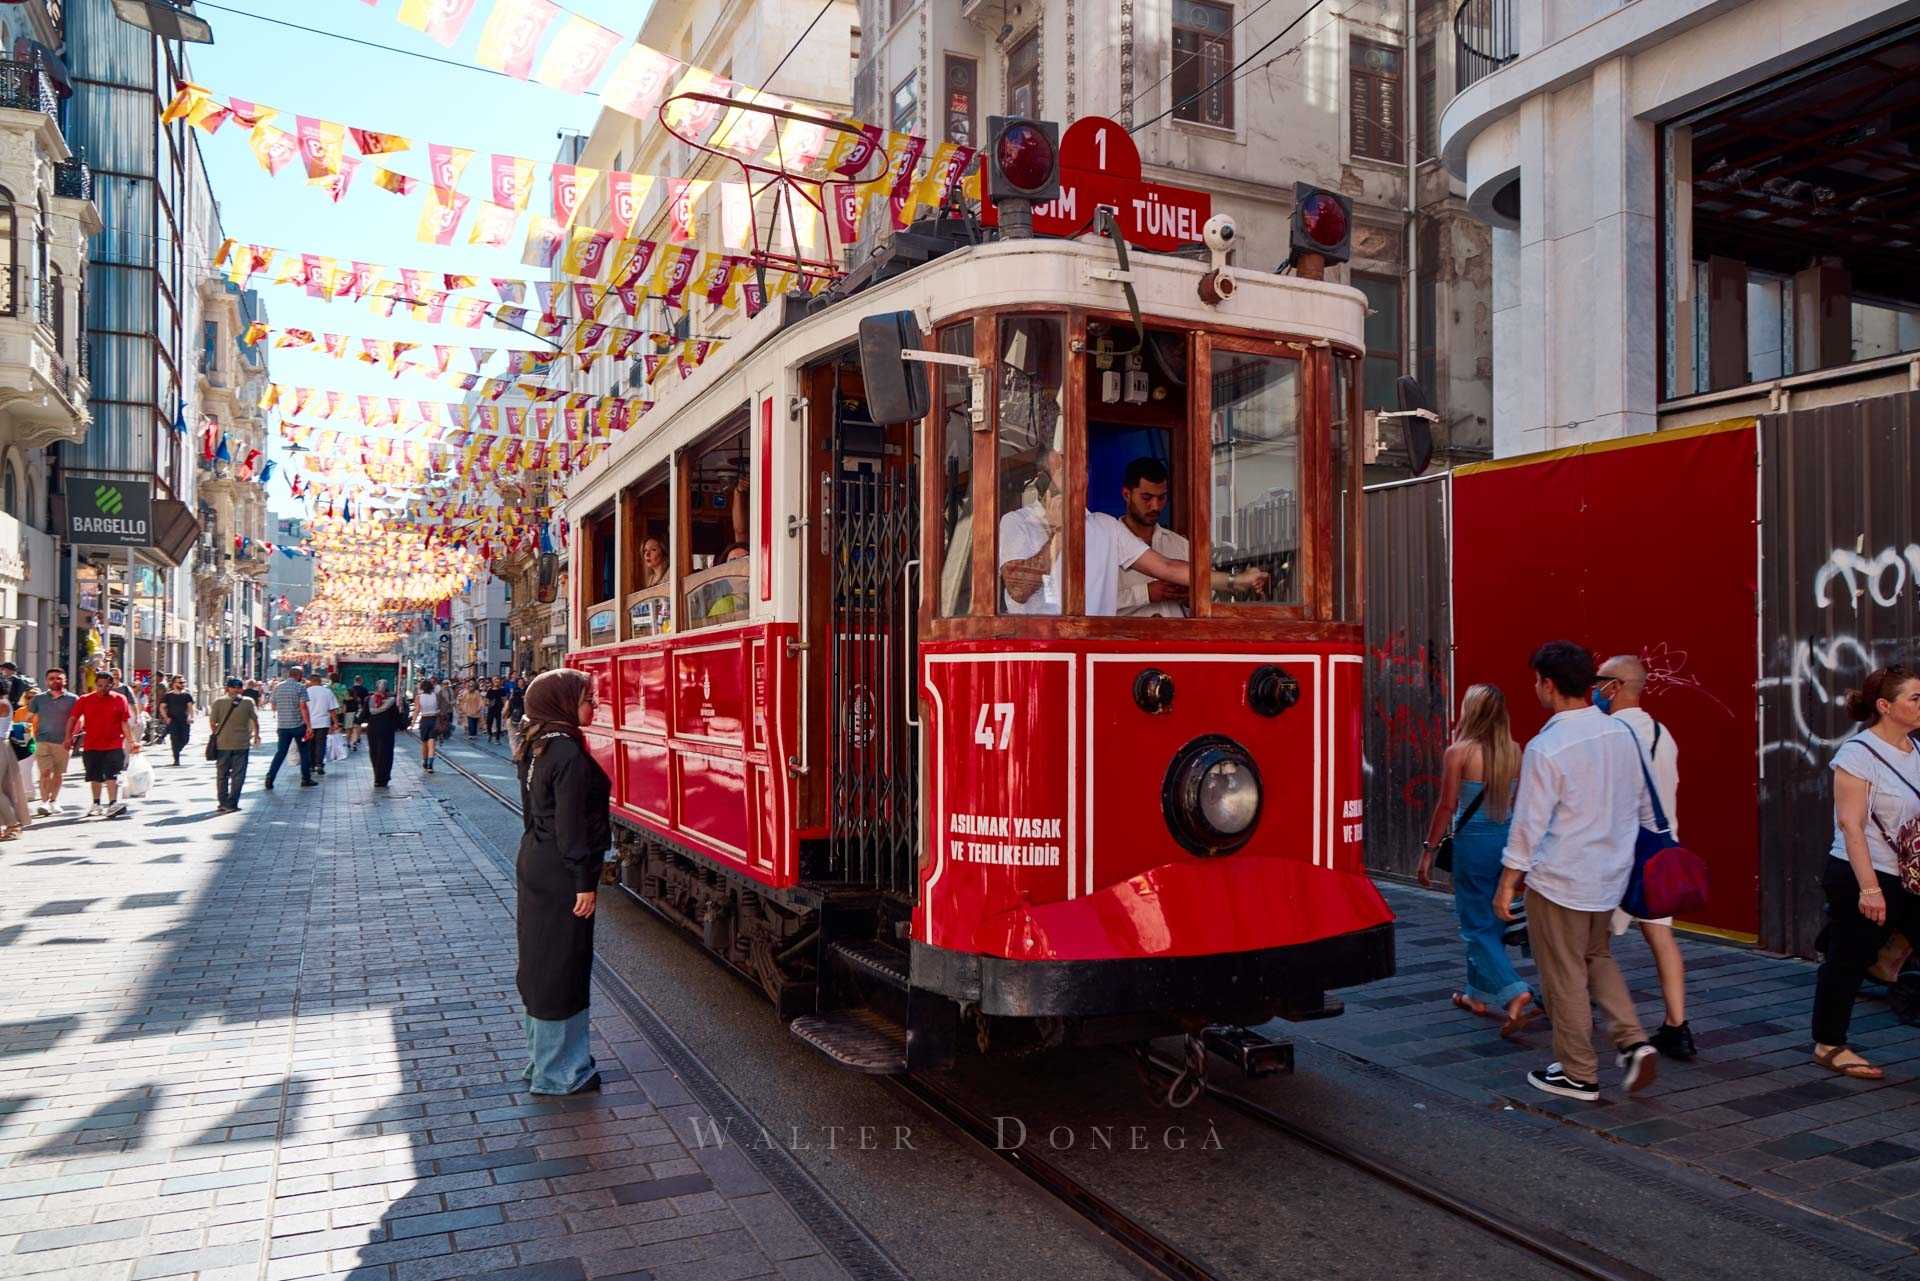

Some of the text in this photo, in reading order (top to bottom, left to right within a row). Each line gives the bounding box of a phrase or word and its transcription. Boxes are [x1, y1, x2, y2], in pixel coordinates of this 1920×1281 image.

[1095, 127, 1107, 170] 1
[1132, 192, 1204, 242] TÜNEL
[73, 516, 147, 535] BARGELLO
[974, 702, 1015, 751] 47
[950, 813, 1062, 839] ASILMAK YASAK
[950, 839, 1060, 866] VE TEHLİKELİDİR
